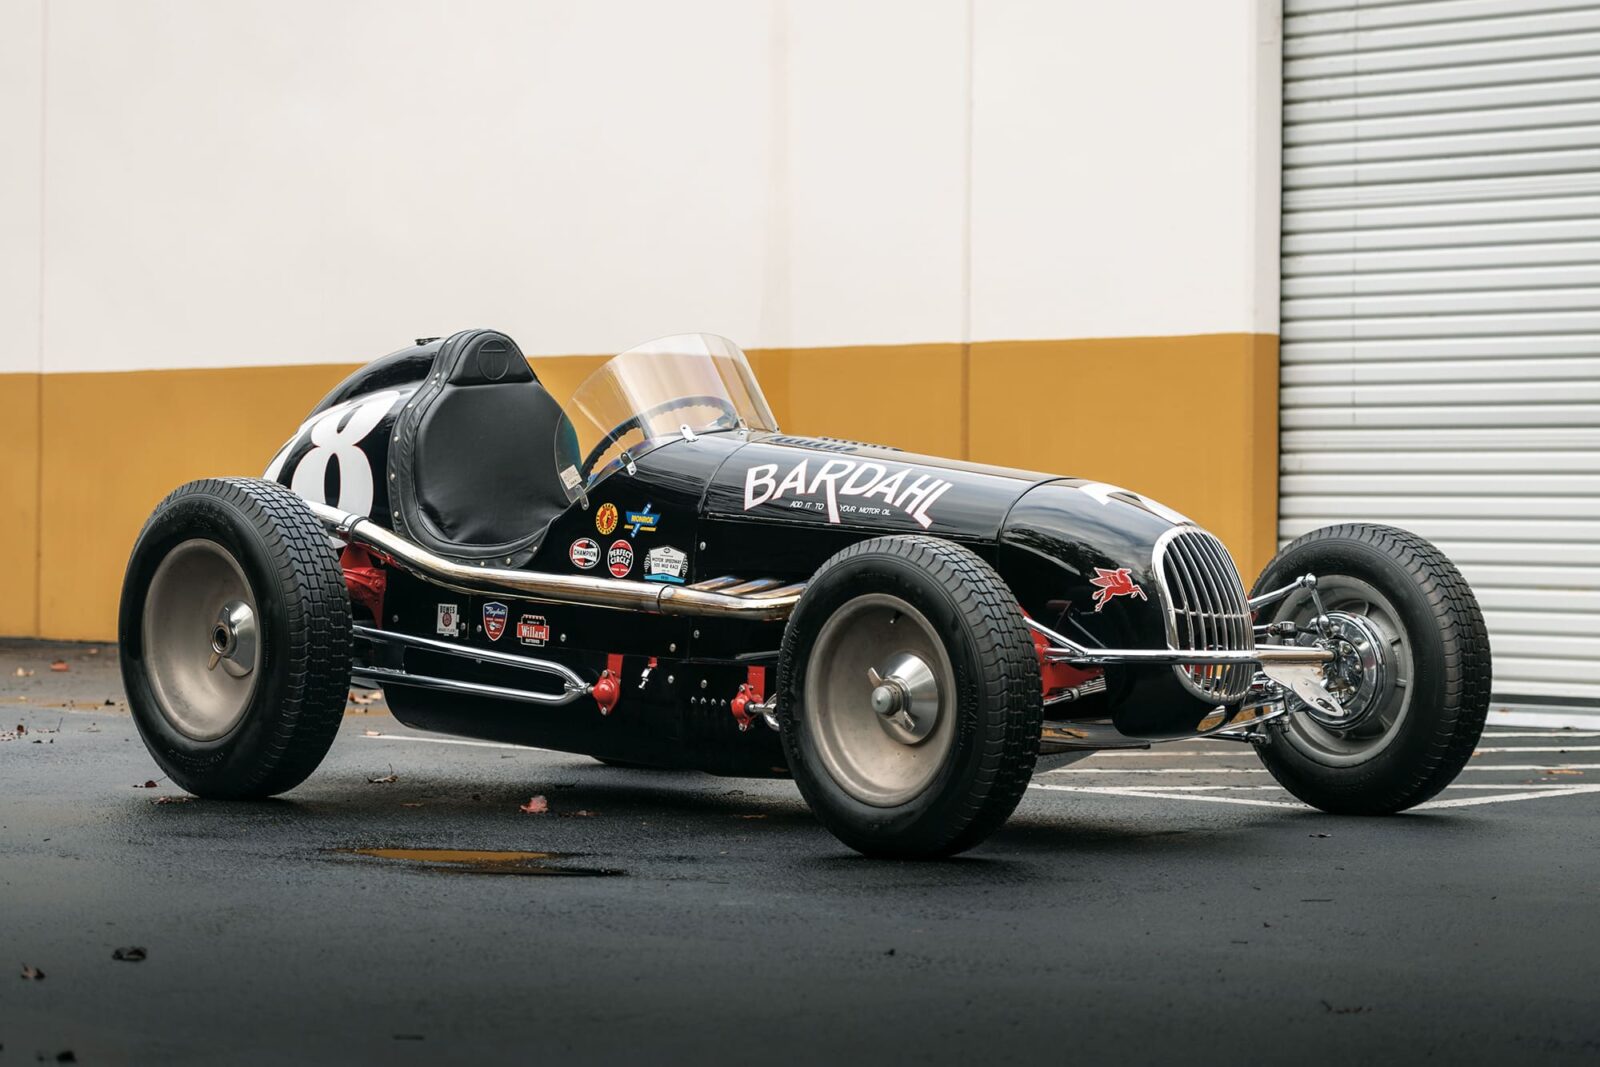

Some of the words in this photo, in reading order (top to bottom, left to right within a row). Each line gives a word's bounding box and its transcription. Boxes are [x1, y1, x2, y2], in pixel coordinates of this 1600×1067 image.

[744, 458, 954, 530] BARDAHL
[789, 500, 803, 509] ADD
[804, 501, 812, 509] IT
[815, 502, 824, 510] TO
[839, 504, 857, 513] YOUR
[858, 506, 880, 515] MOTOR
[881, 508, 892, 516] OIL
[574, 548, 596, 557] CHAMPION
[609, 549, 632, 558] PERFECT
[610, 556, 630, 566] CIRCLE
[521, 625, 546, 639] Willard
